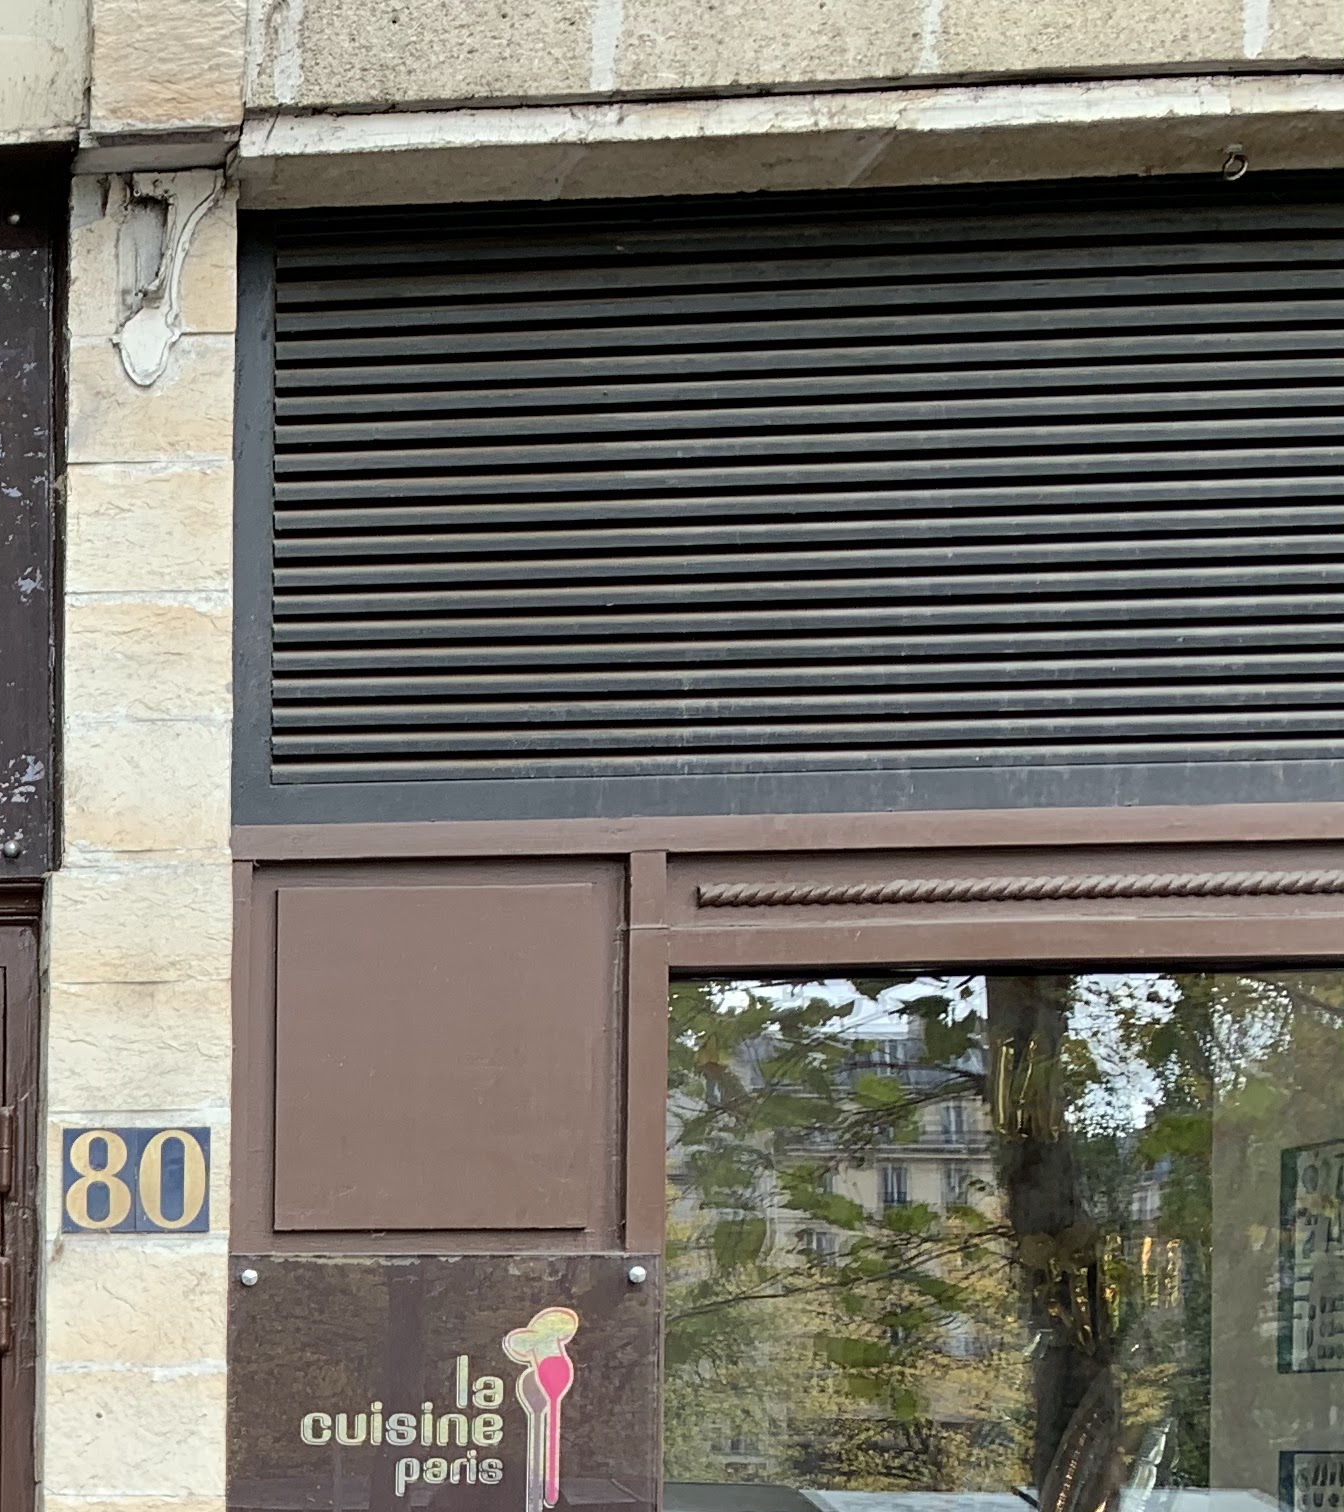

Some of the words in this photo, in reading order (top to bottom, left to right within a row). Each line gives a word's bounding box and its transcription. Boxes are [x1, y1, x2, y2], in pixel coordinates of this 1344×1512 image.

[65, 1130, 206, 1229] 80
[457, 1355, 504, 1409] la
[300, 1402, 504, 1446] cuisine
[396, 1450, 504, 1496] paris
